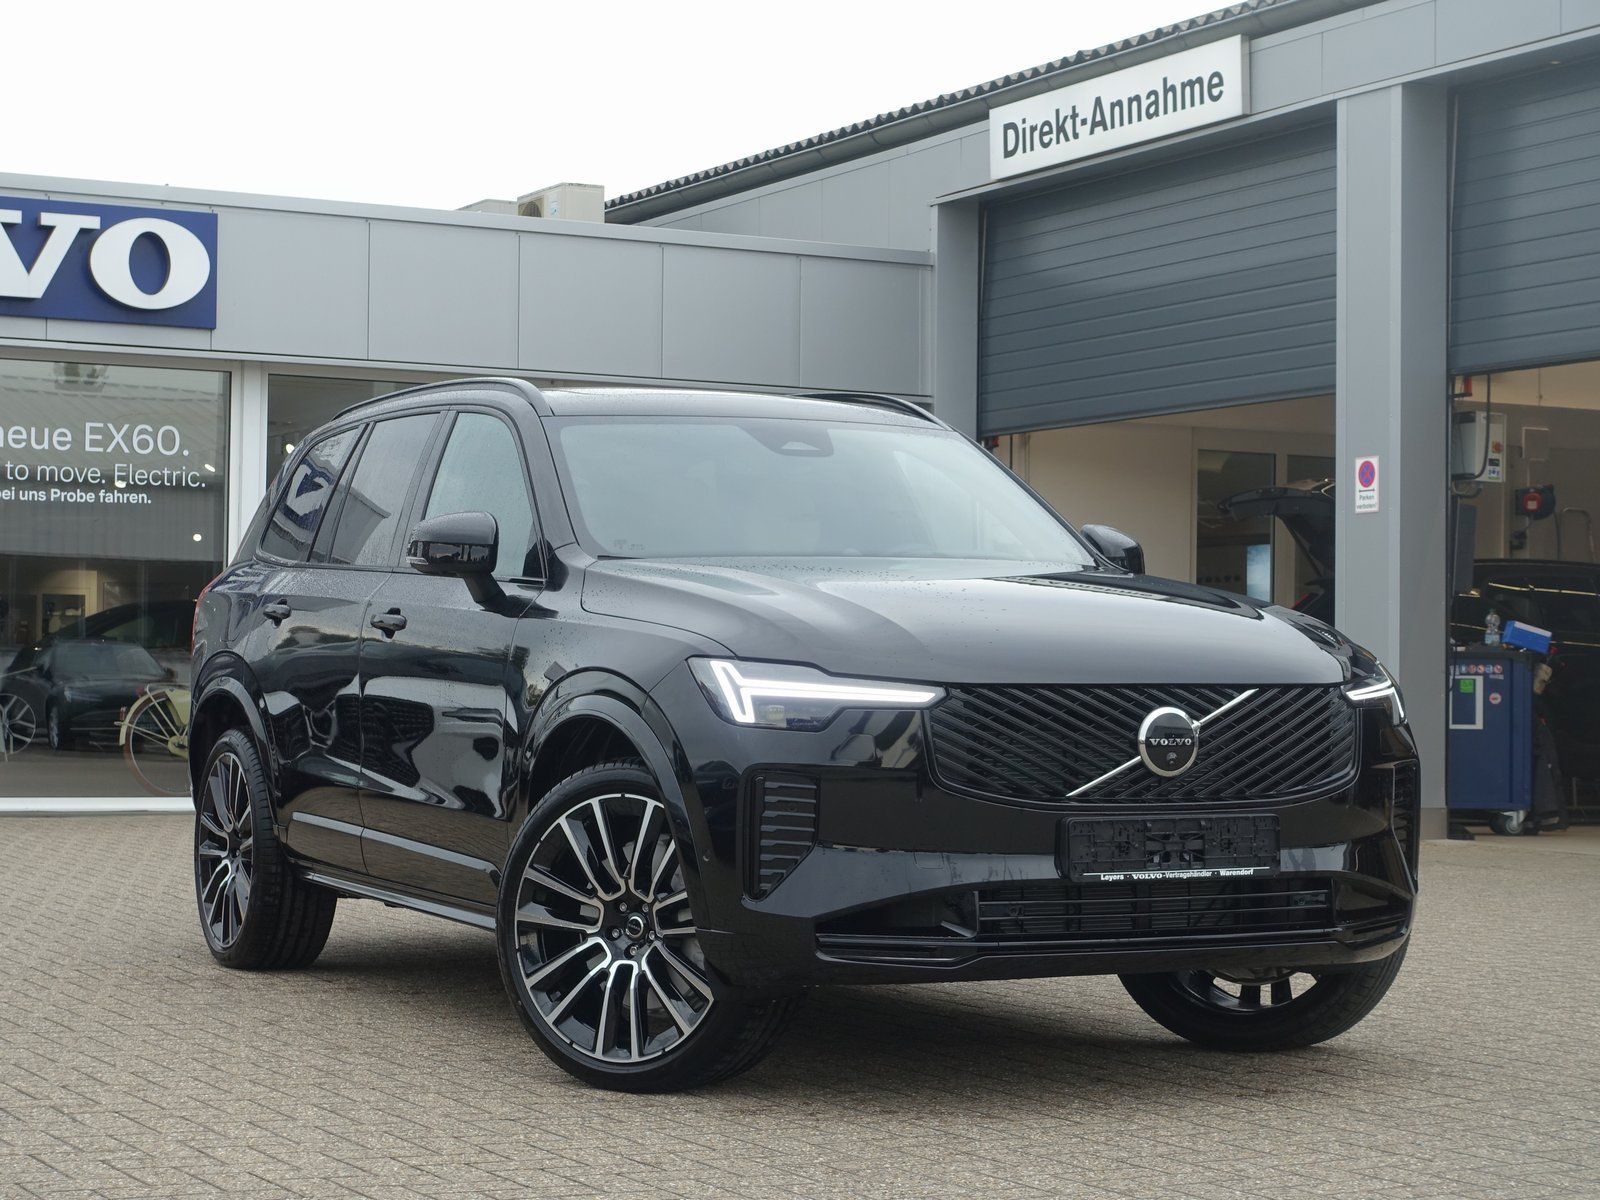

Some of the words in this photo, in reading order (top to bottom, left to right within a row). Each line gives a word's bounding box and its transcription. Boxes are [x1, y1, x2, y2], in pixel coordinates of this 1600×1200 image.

[1003, 70, 1224, 159] Direkt-Annahme
[0, 425, 72, 451] eue
[84, 422, 189, 456] EX60.
[5, 460, 29, 481] to
[37, 464, 106, 485] move.
[114, 463, 206, 488] Electric.
[0, 487, 15, 501] ei
[19, 490, 47, 502] uns
[50, 488, 96, 503] Probe
[99, 489, 152, 504] fahren.
[1149, 738, 1192, 746] VOLVO
[1219, 868, 1254, 877] Warendorf
